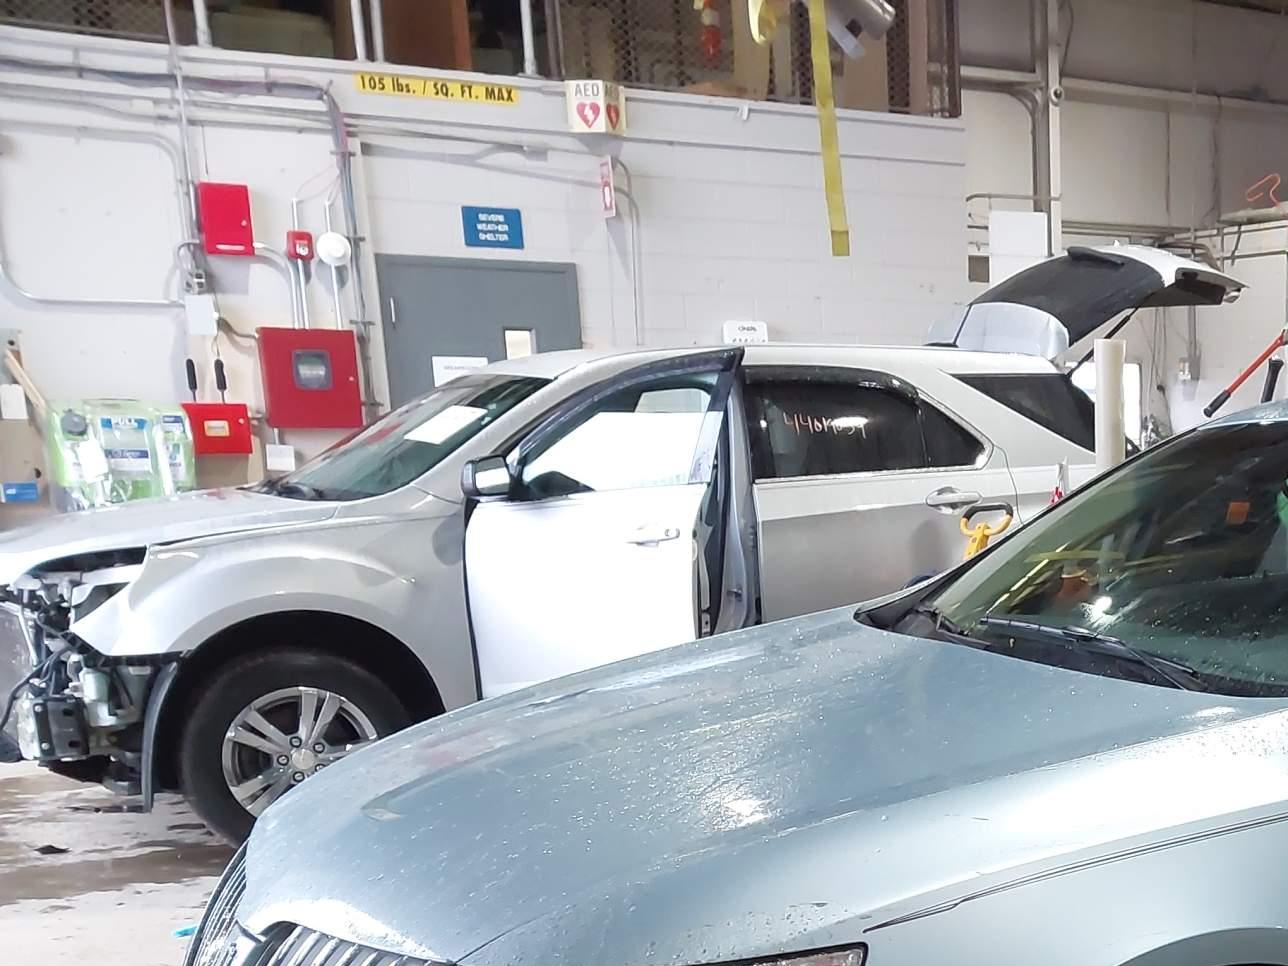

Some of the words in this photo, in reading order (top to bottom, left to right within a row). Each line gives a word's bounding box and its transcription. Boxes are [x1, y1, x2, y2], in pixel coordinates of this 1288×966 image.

[360, 75, 385, 91] 105
[391, 77, 416, 94] lbs.
[422, 79, 427, 95] /
[433, 83, 455, 98] SQ.
[460, 84, 479, 99] FT.
[485, 86, 514, 103] MAX
[575, 83, 600, 97] AED
[478, 213, 504, 222] SEVERE
[476, 223, 509, 232] WEATHER
[478, 232, 509, 241] SHELTER
